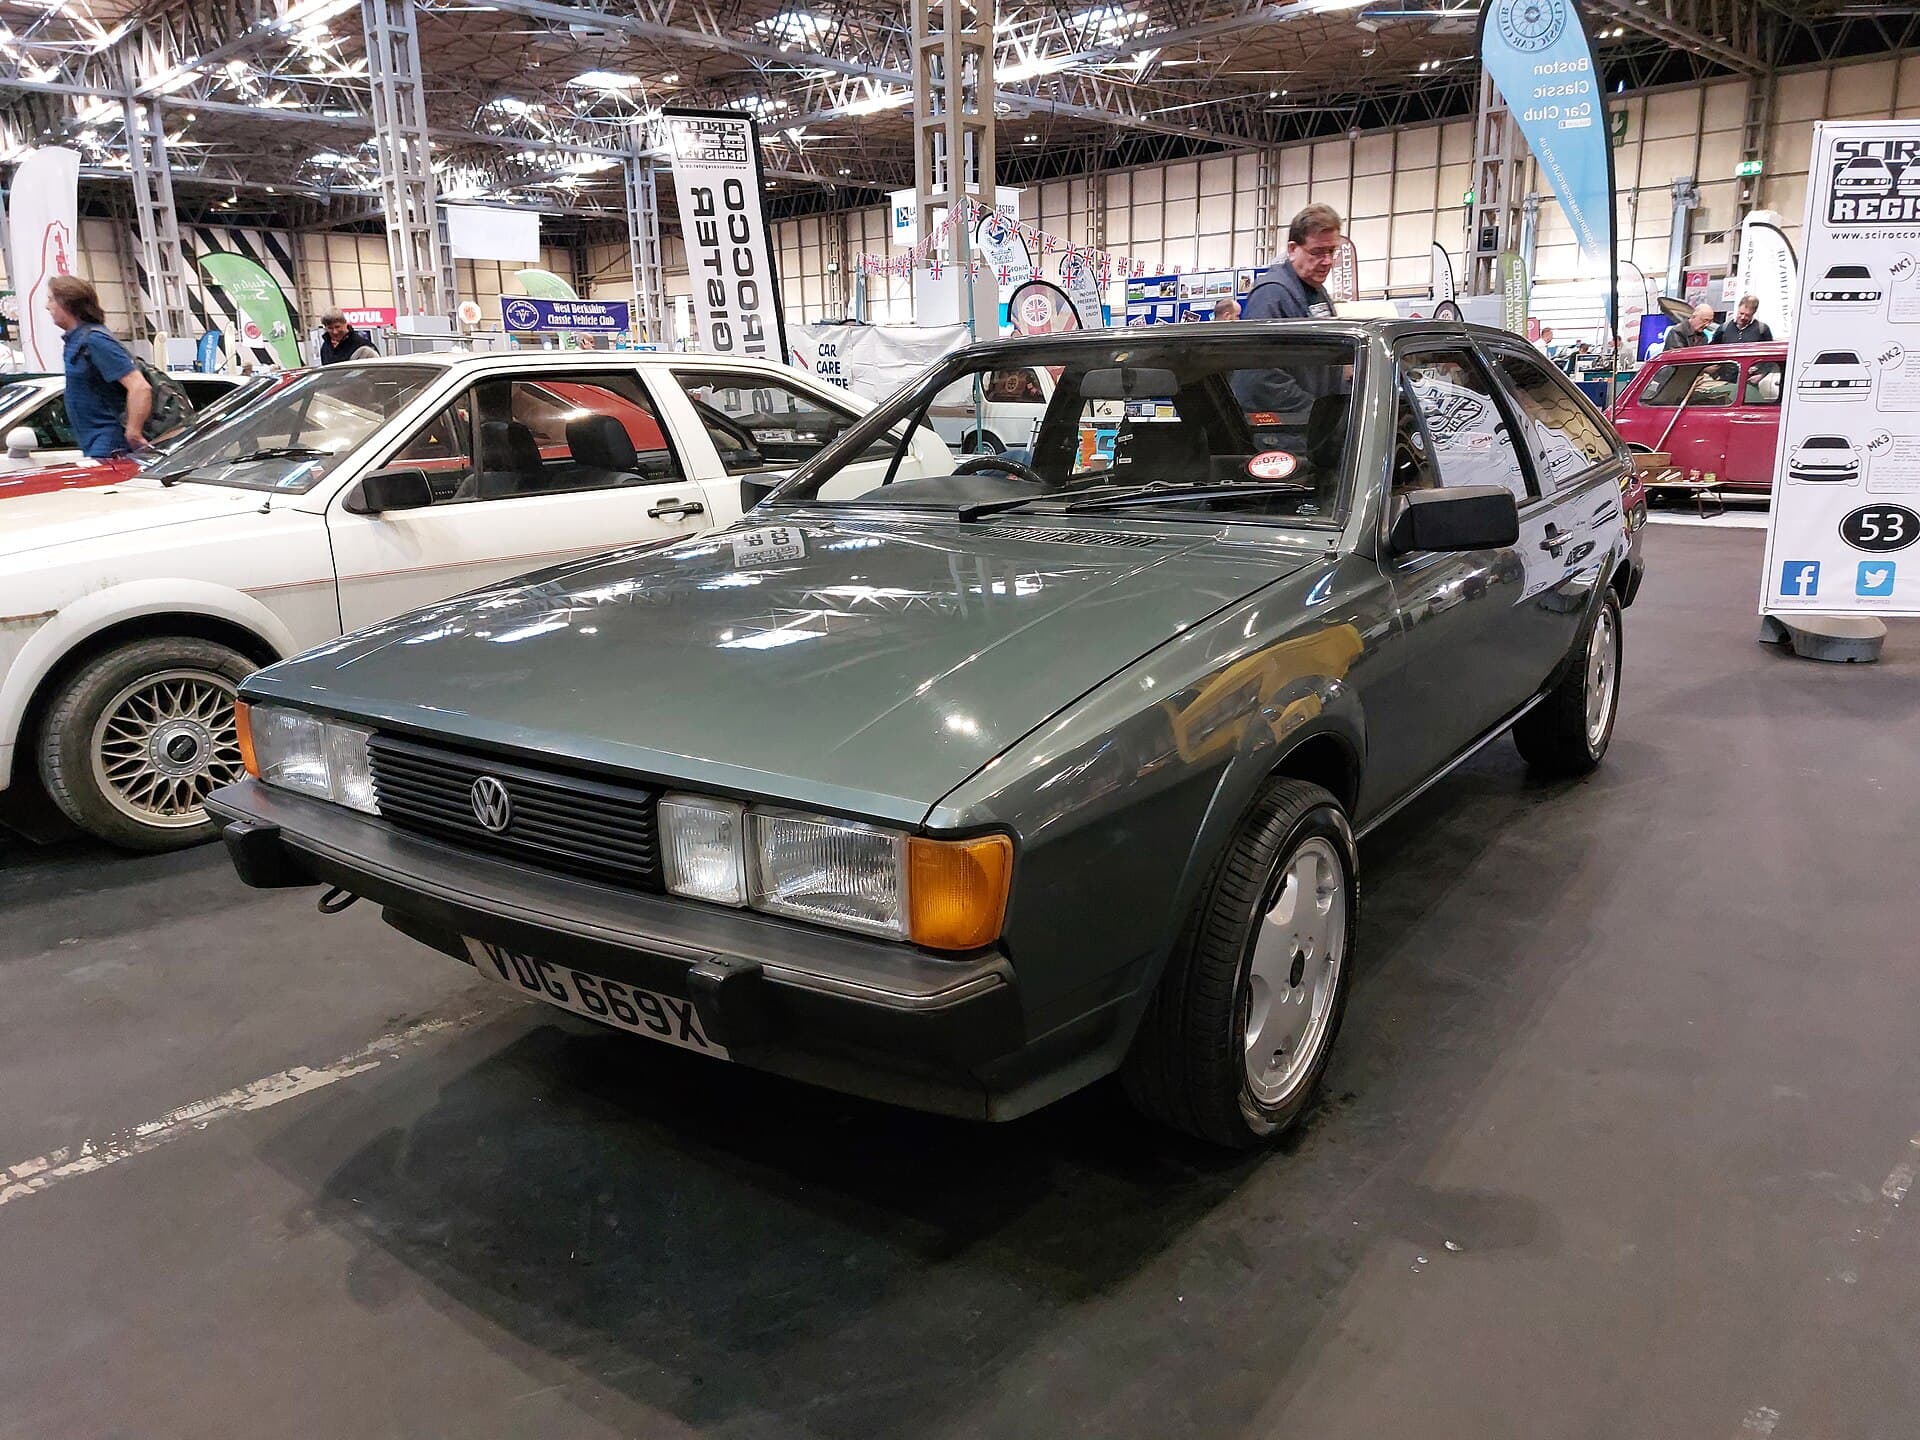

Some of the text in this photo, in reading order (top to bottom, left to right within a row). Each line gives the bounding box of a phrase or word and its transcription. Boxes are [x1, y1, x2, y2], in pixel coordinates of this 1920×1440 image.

[1889, 258, 1911, 276] MK1
[553, 302, 607, 314] West Berkshire
[547, 314, 572, 325] Classic
[573, 315, 599, 326] Vehicle
[599, 315, 616, 326] Club
[818, 343, 837, 357] CAR
[1877, 347, 1901, 365] MK2
[816, 361, 841, 375] CARE
[1867, 434, 1890, 452] MK3
[1859, 513, 1904, 541] 53
[571, 971, 709, 1049] 669X
